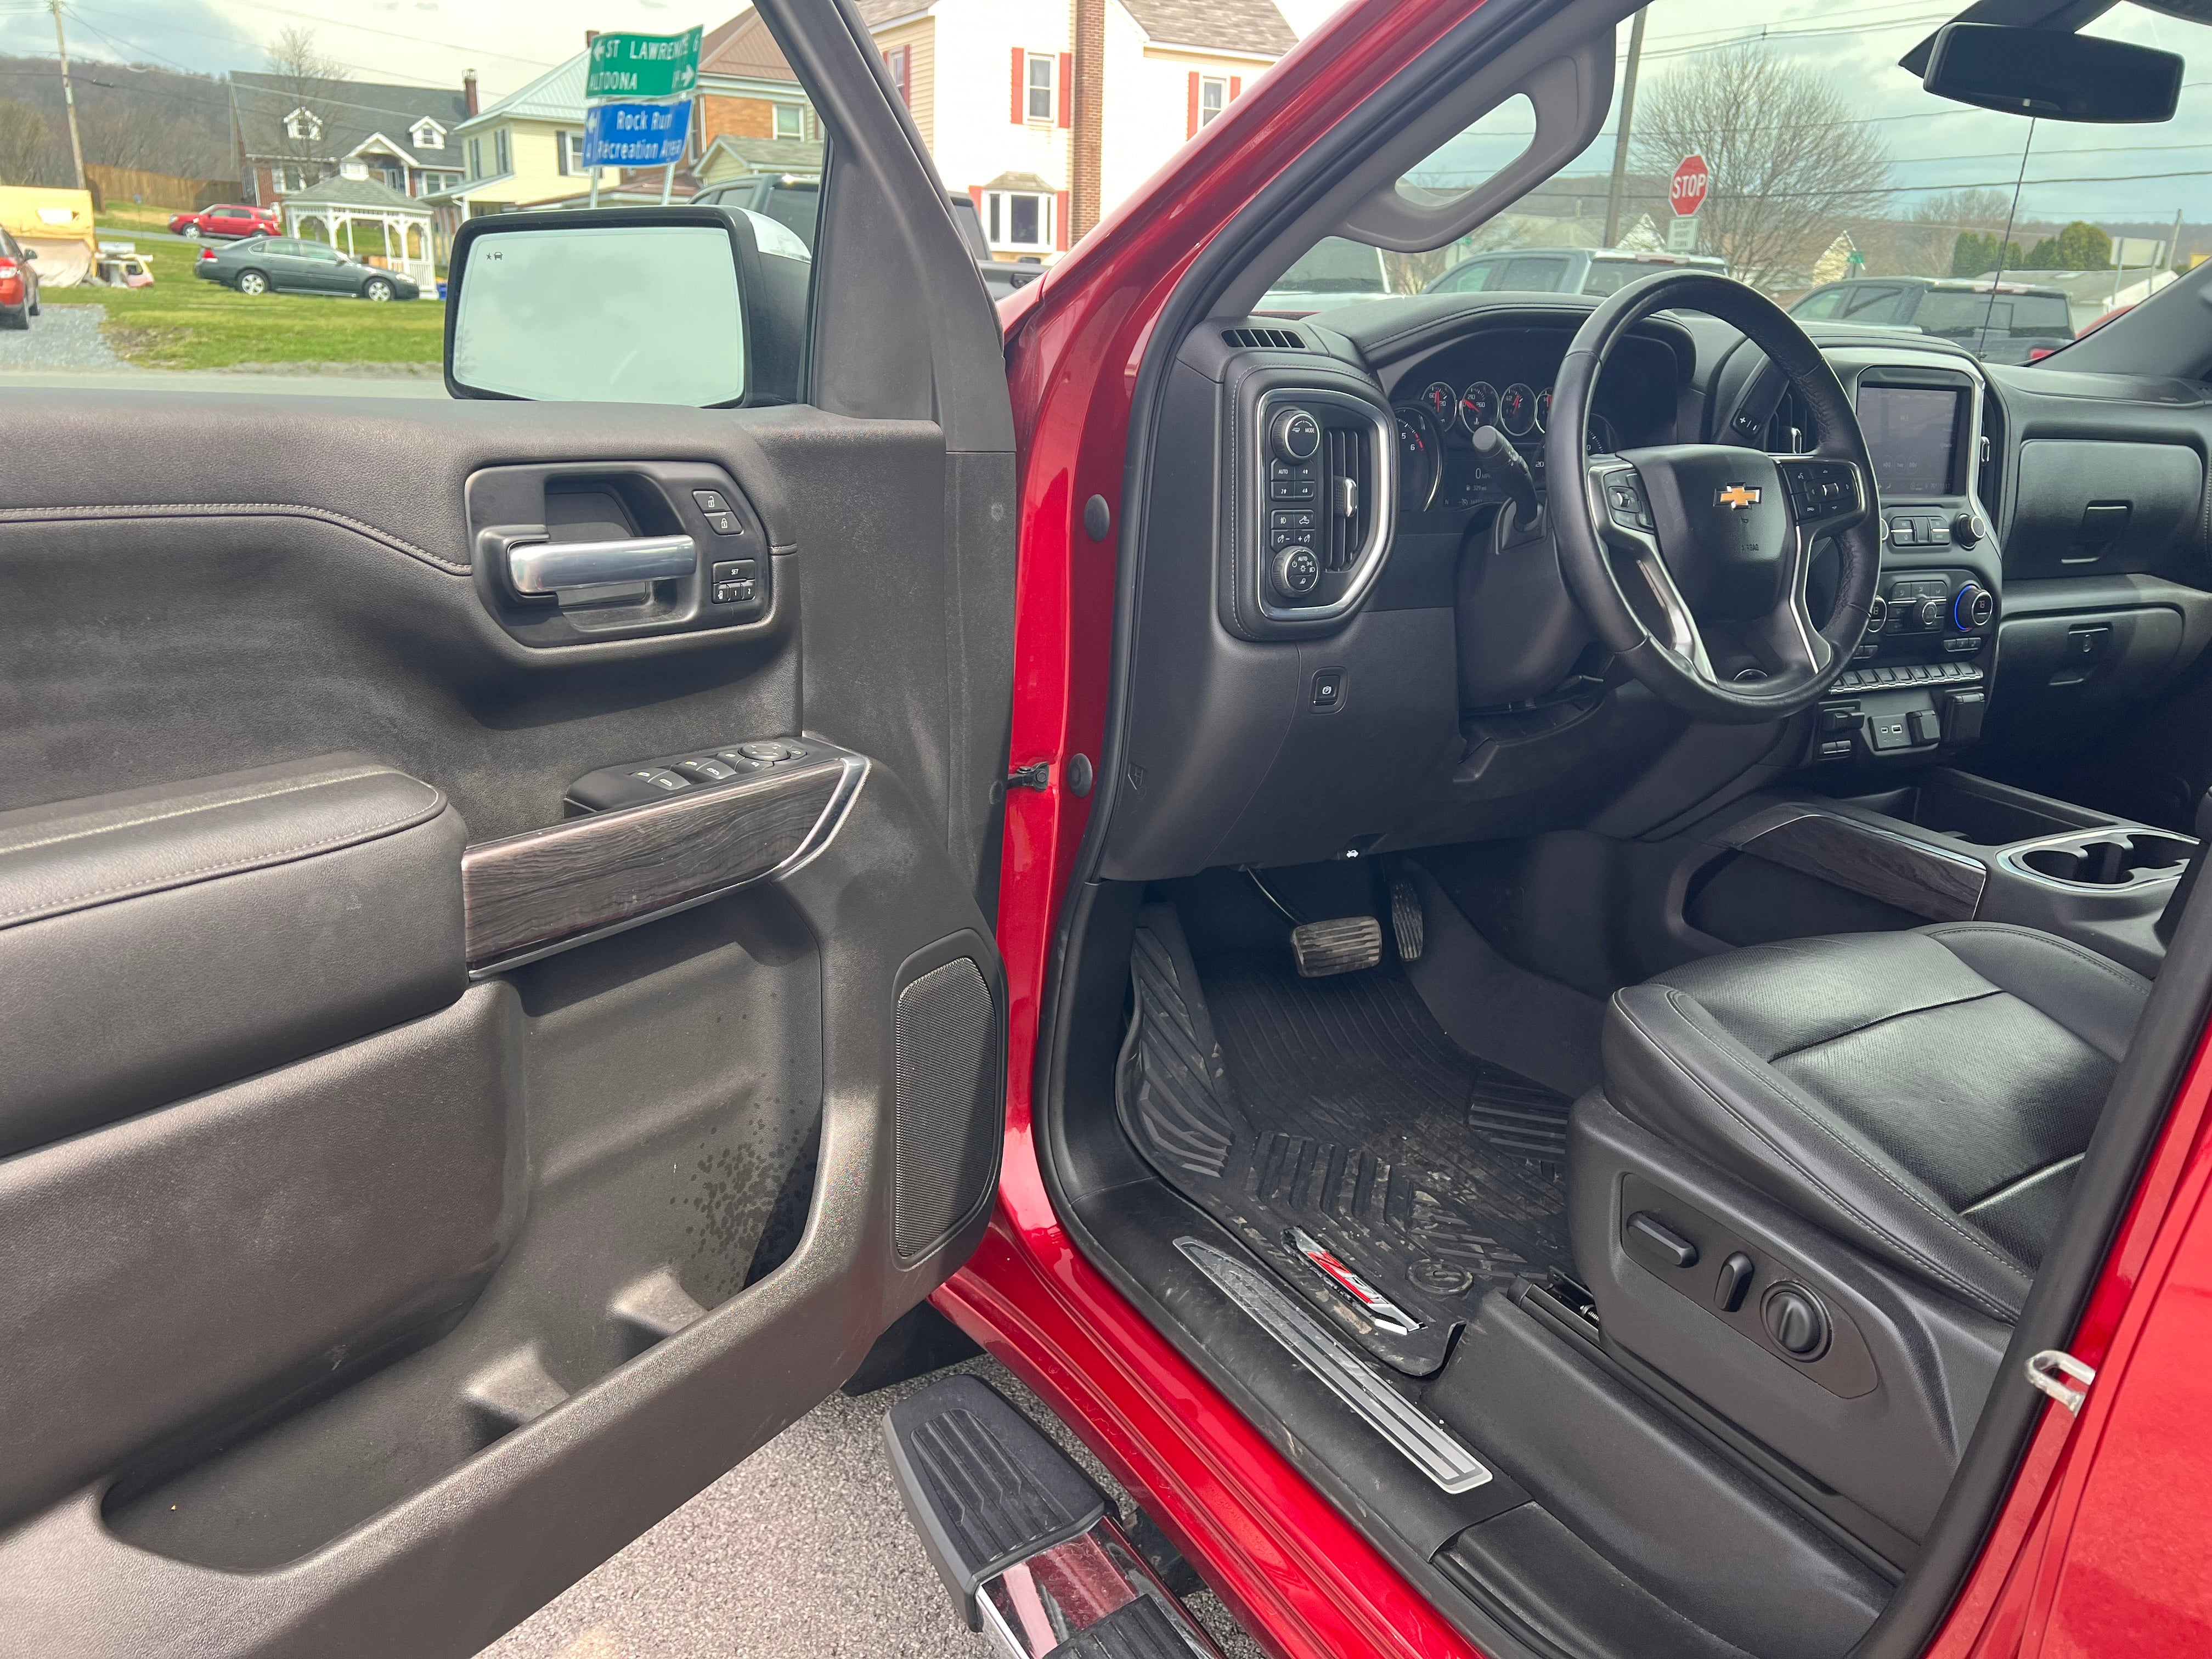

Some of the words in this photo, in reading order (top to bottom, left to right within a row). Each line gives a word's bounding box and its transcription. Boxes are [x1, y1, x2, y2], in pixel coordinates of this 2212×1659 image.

[606, 39, 621, 58] ST
[589, 71, 638, 91] ALTOONA
[616, 110, 648, 131] Rock
[651, 111, 673, 131] Run
[597, 139, 659, 160] Recreation
[1672, 173, 1706, 199] STOP
[1475, 467, 1482, 479] 0
